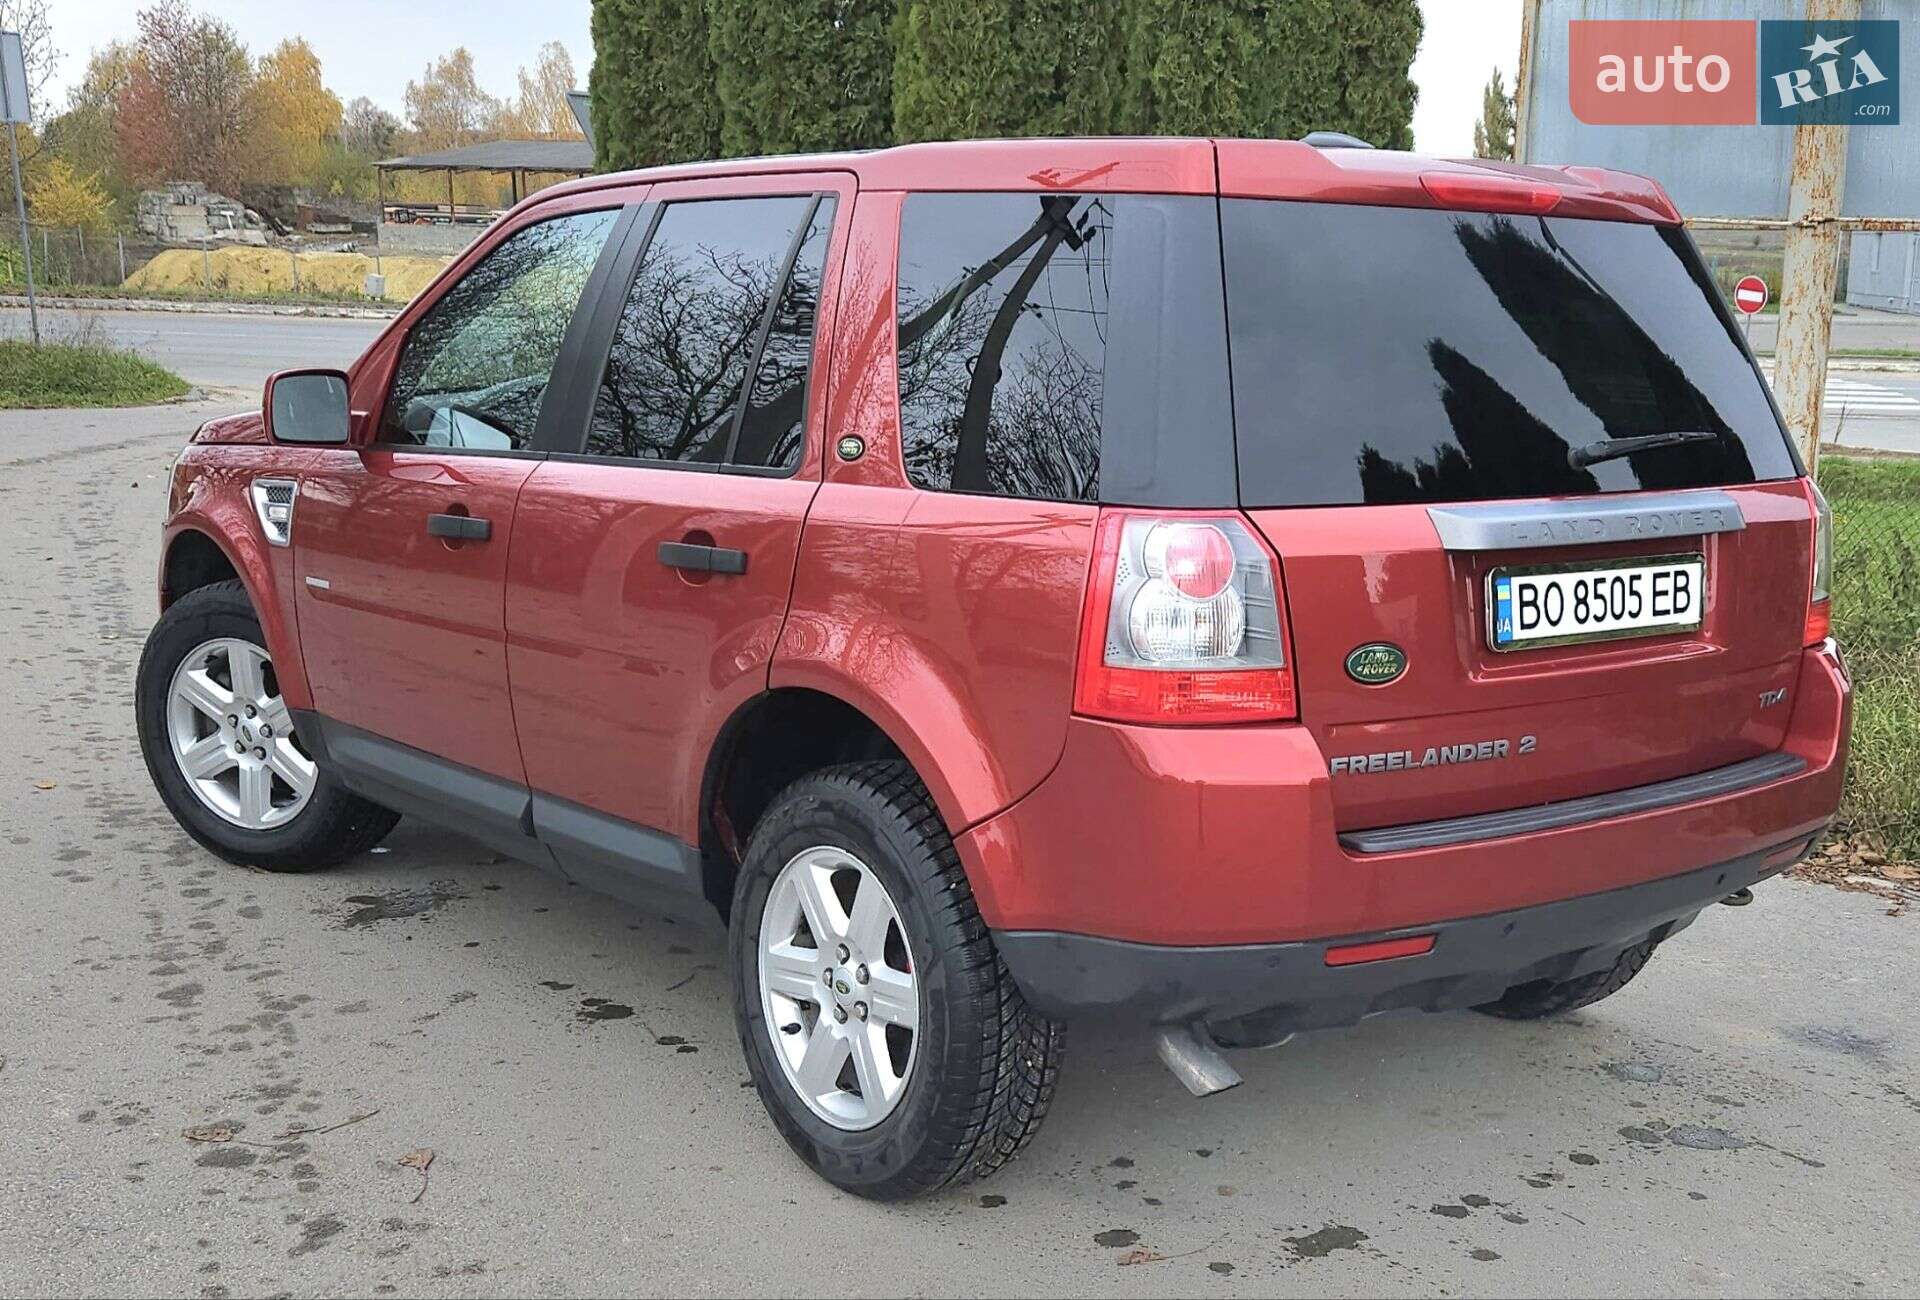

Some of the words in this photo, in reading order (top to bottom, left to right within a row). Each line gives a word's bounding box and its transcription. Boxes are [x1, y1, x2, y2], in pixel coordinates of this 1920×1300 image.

[1511, 518, 1607, 541] LAND
[1624, 509, 1725, 537] ROVER
[1518, 581, 1564, 631] BO
[1573, 573, 1643, 625] 8505
[1652, 569, 1691, 617] EB
[1497, 618, 1512, 634] UA
[1360, 652, 1389, 665] LAND
[1362, 663, 1398, 675] ROVER
[1330, 739, 1510, 775] FREELANDER
[1518, 735, 1537, 755] 2
